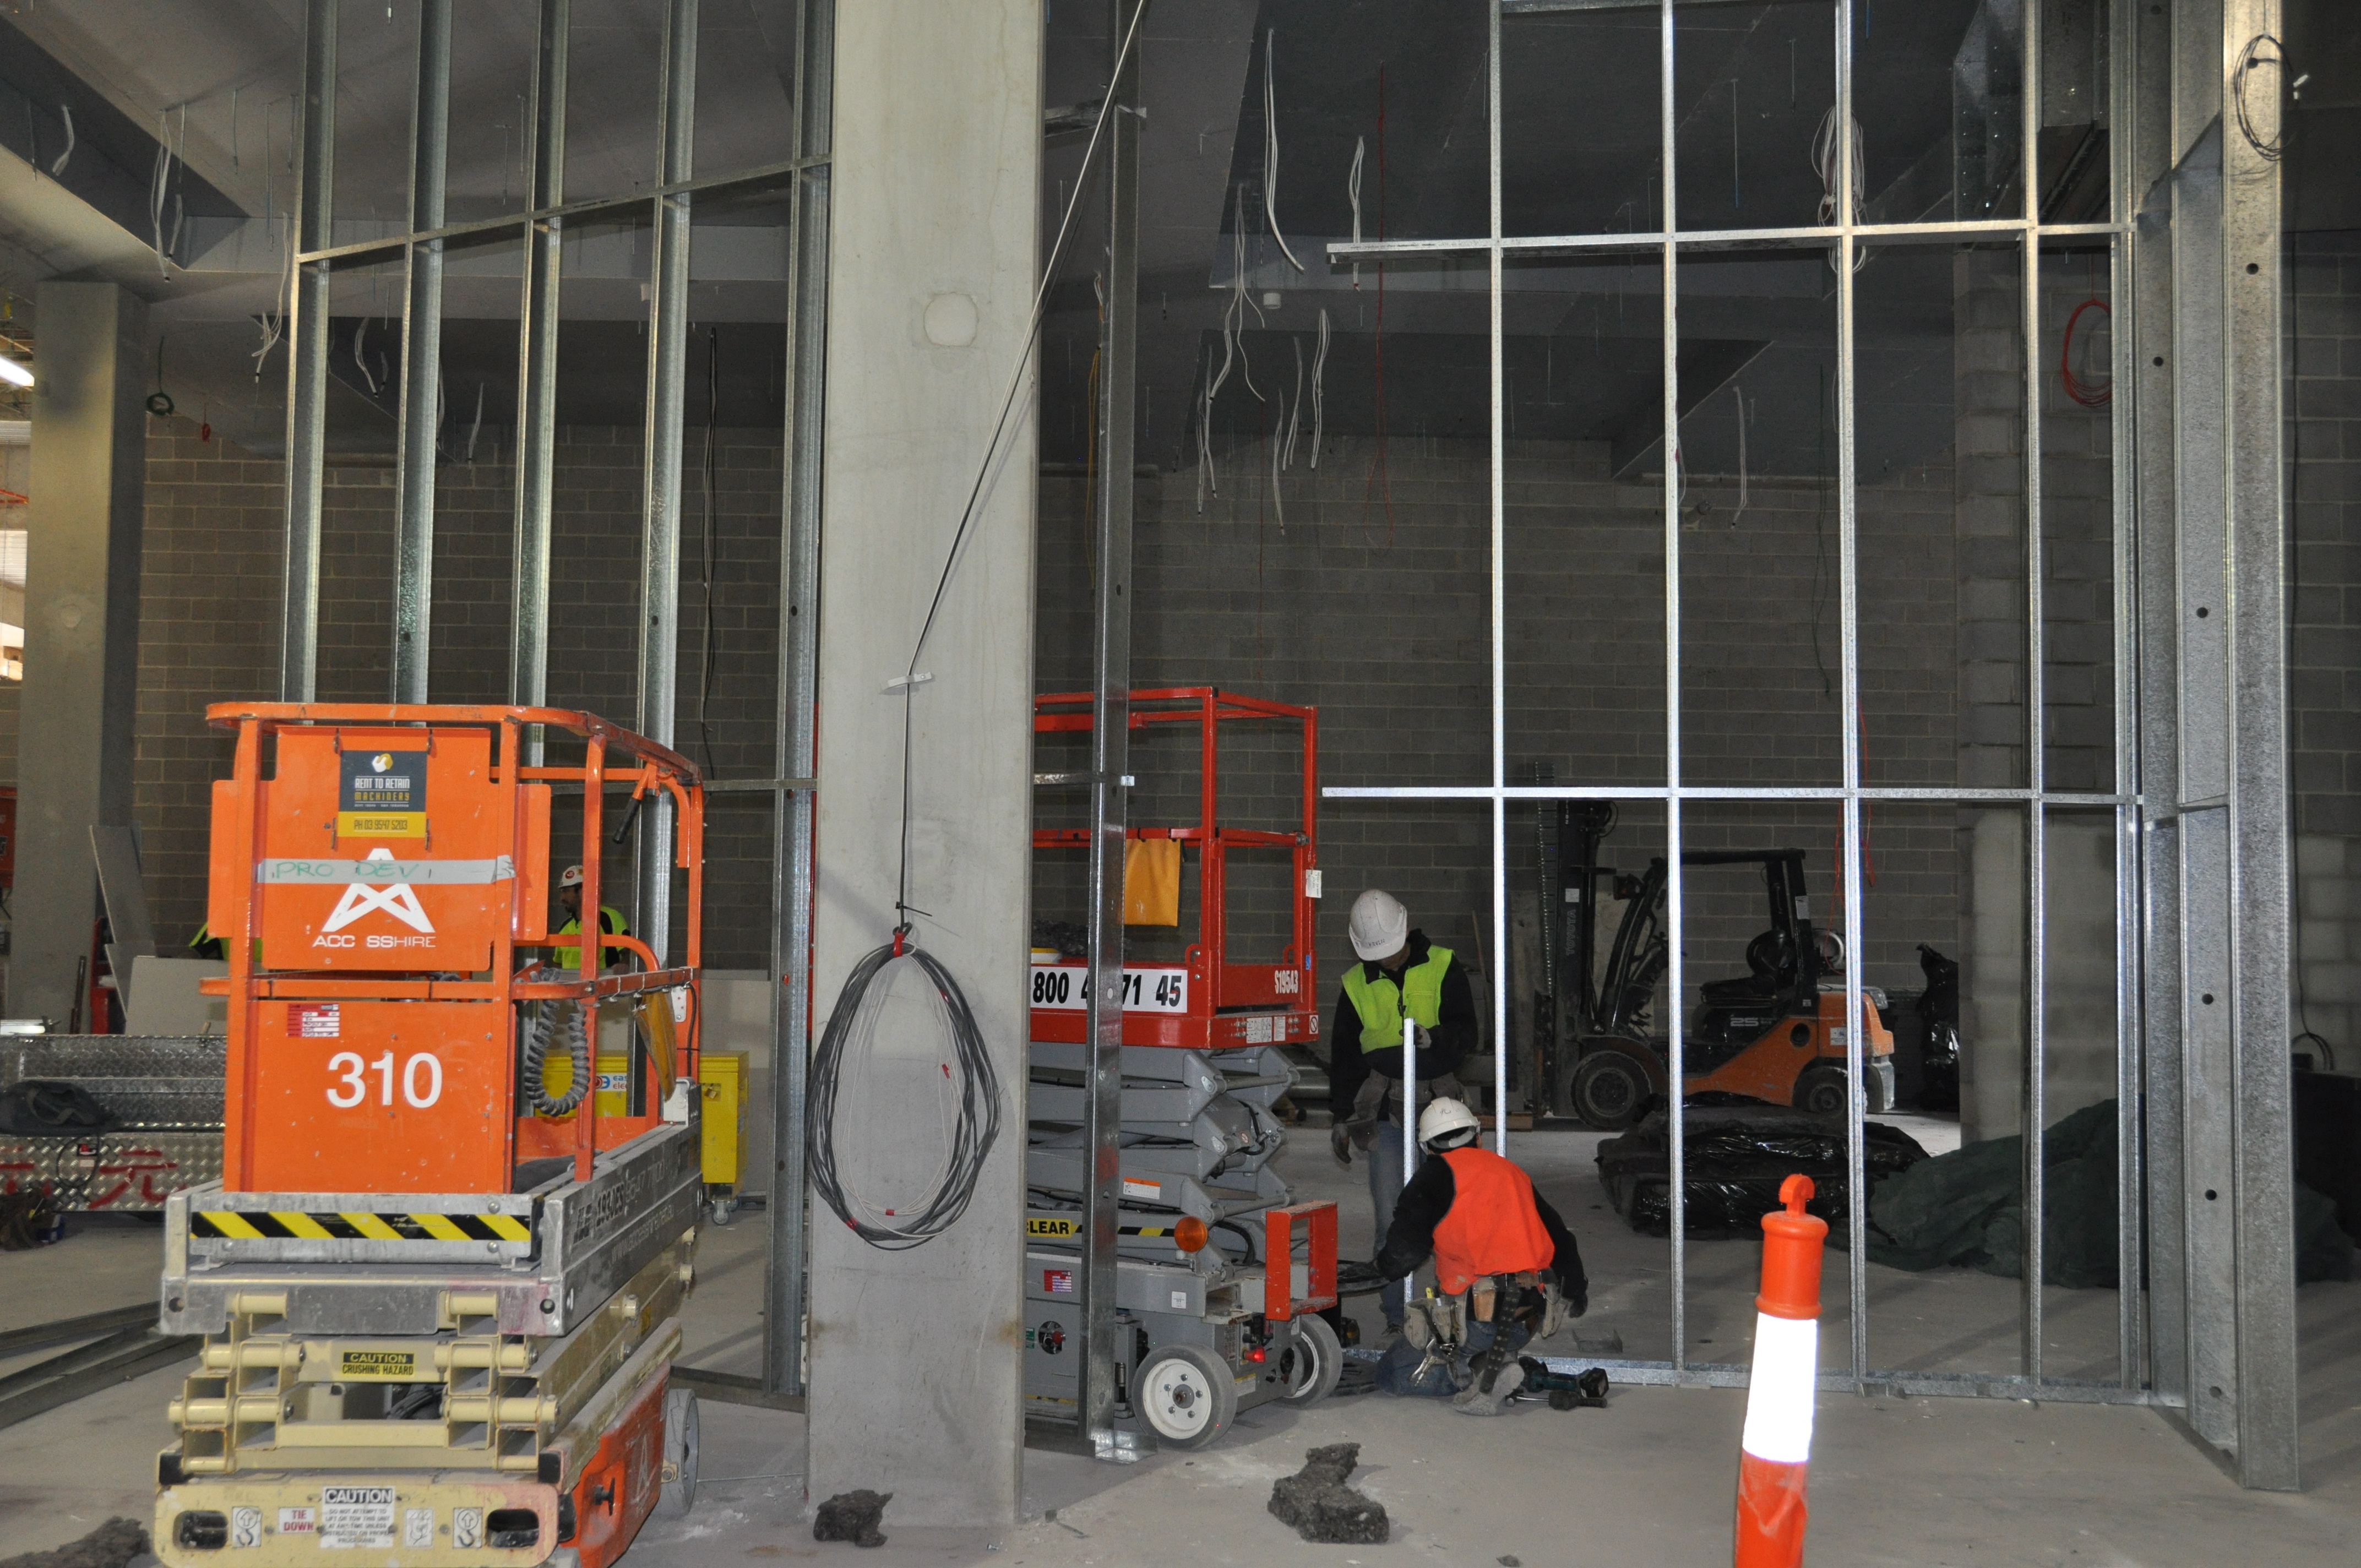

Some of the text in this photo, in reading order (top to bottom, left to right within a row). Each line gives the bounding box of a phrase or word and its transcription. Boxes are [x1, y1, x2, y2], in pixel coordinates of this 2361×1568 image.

[355, 778, 410, 789] RENT TO RETAIN
[355, 792, 410, 801] MACHINERY
[275, 861, 334, 879] PRO
[1566, 909, 1576, 956] TOYOTA
[1275, 970, 1298, 994] S19543
[1033, 971, 1069, 1004] 800
[1155, 975, 1182, 1007] 45
[1730, 1017, 1759, 1027] 25
[327, 1052, 443, 1108] 310
[350, 1353, 406, 1363] CAUTION
[342, 1364, 414, 1375] CRUSHING HAZARD
[326, 1489, 393, 1504] CAUTION
[291, 1510, 307, 1520] TIE
[284, 1521, 314, 1532] DOWN
